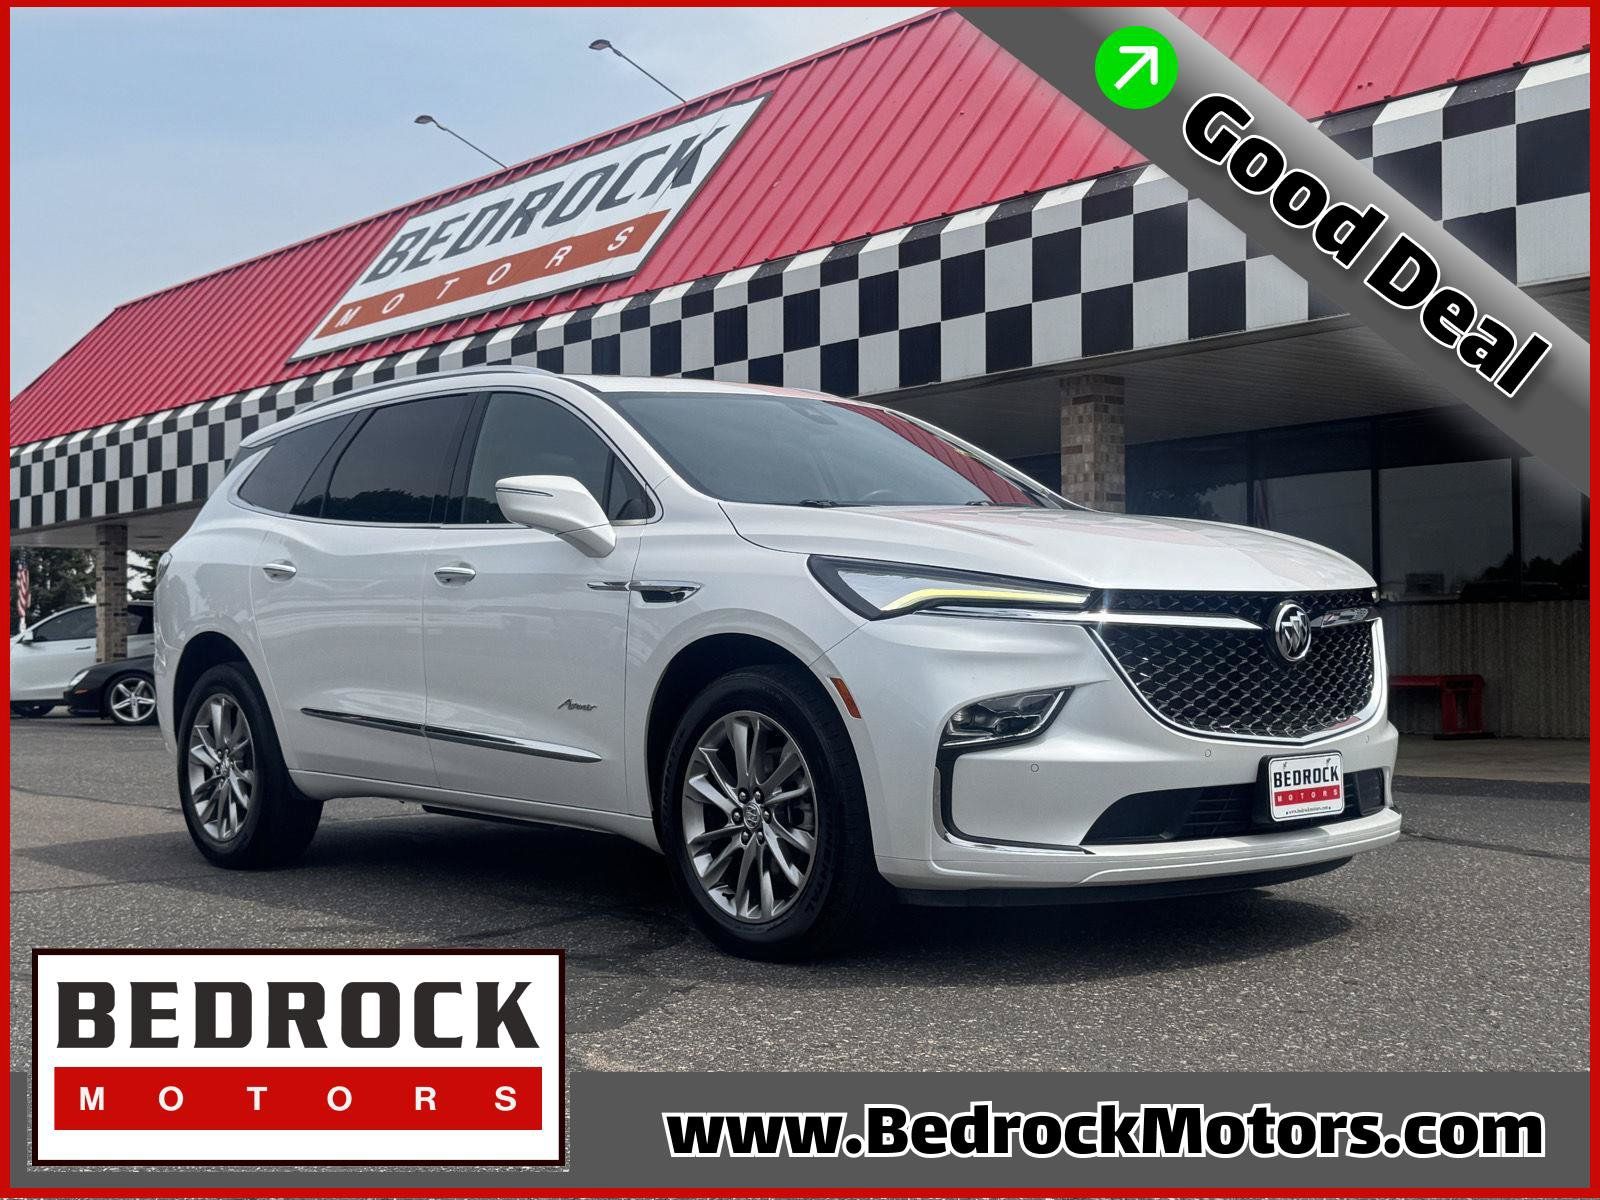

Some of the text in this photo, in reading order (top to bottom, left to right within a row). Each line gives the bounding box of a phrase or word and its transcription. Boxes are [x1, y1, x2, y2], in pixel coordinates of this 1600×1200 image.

[361, 125, 729, 285] BEDROCK
[335, 226, 633, 328] MOTORS
[1273, 765, 1339, 789] BEDROCK
[1277, 788, 1338, 803] MOTORS
